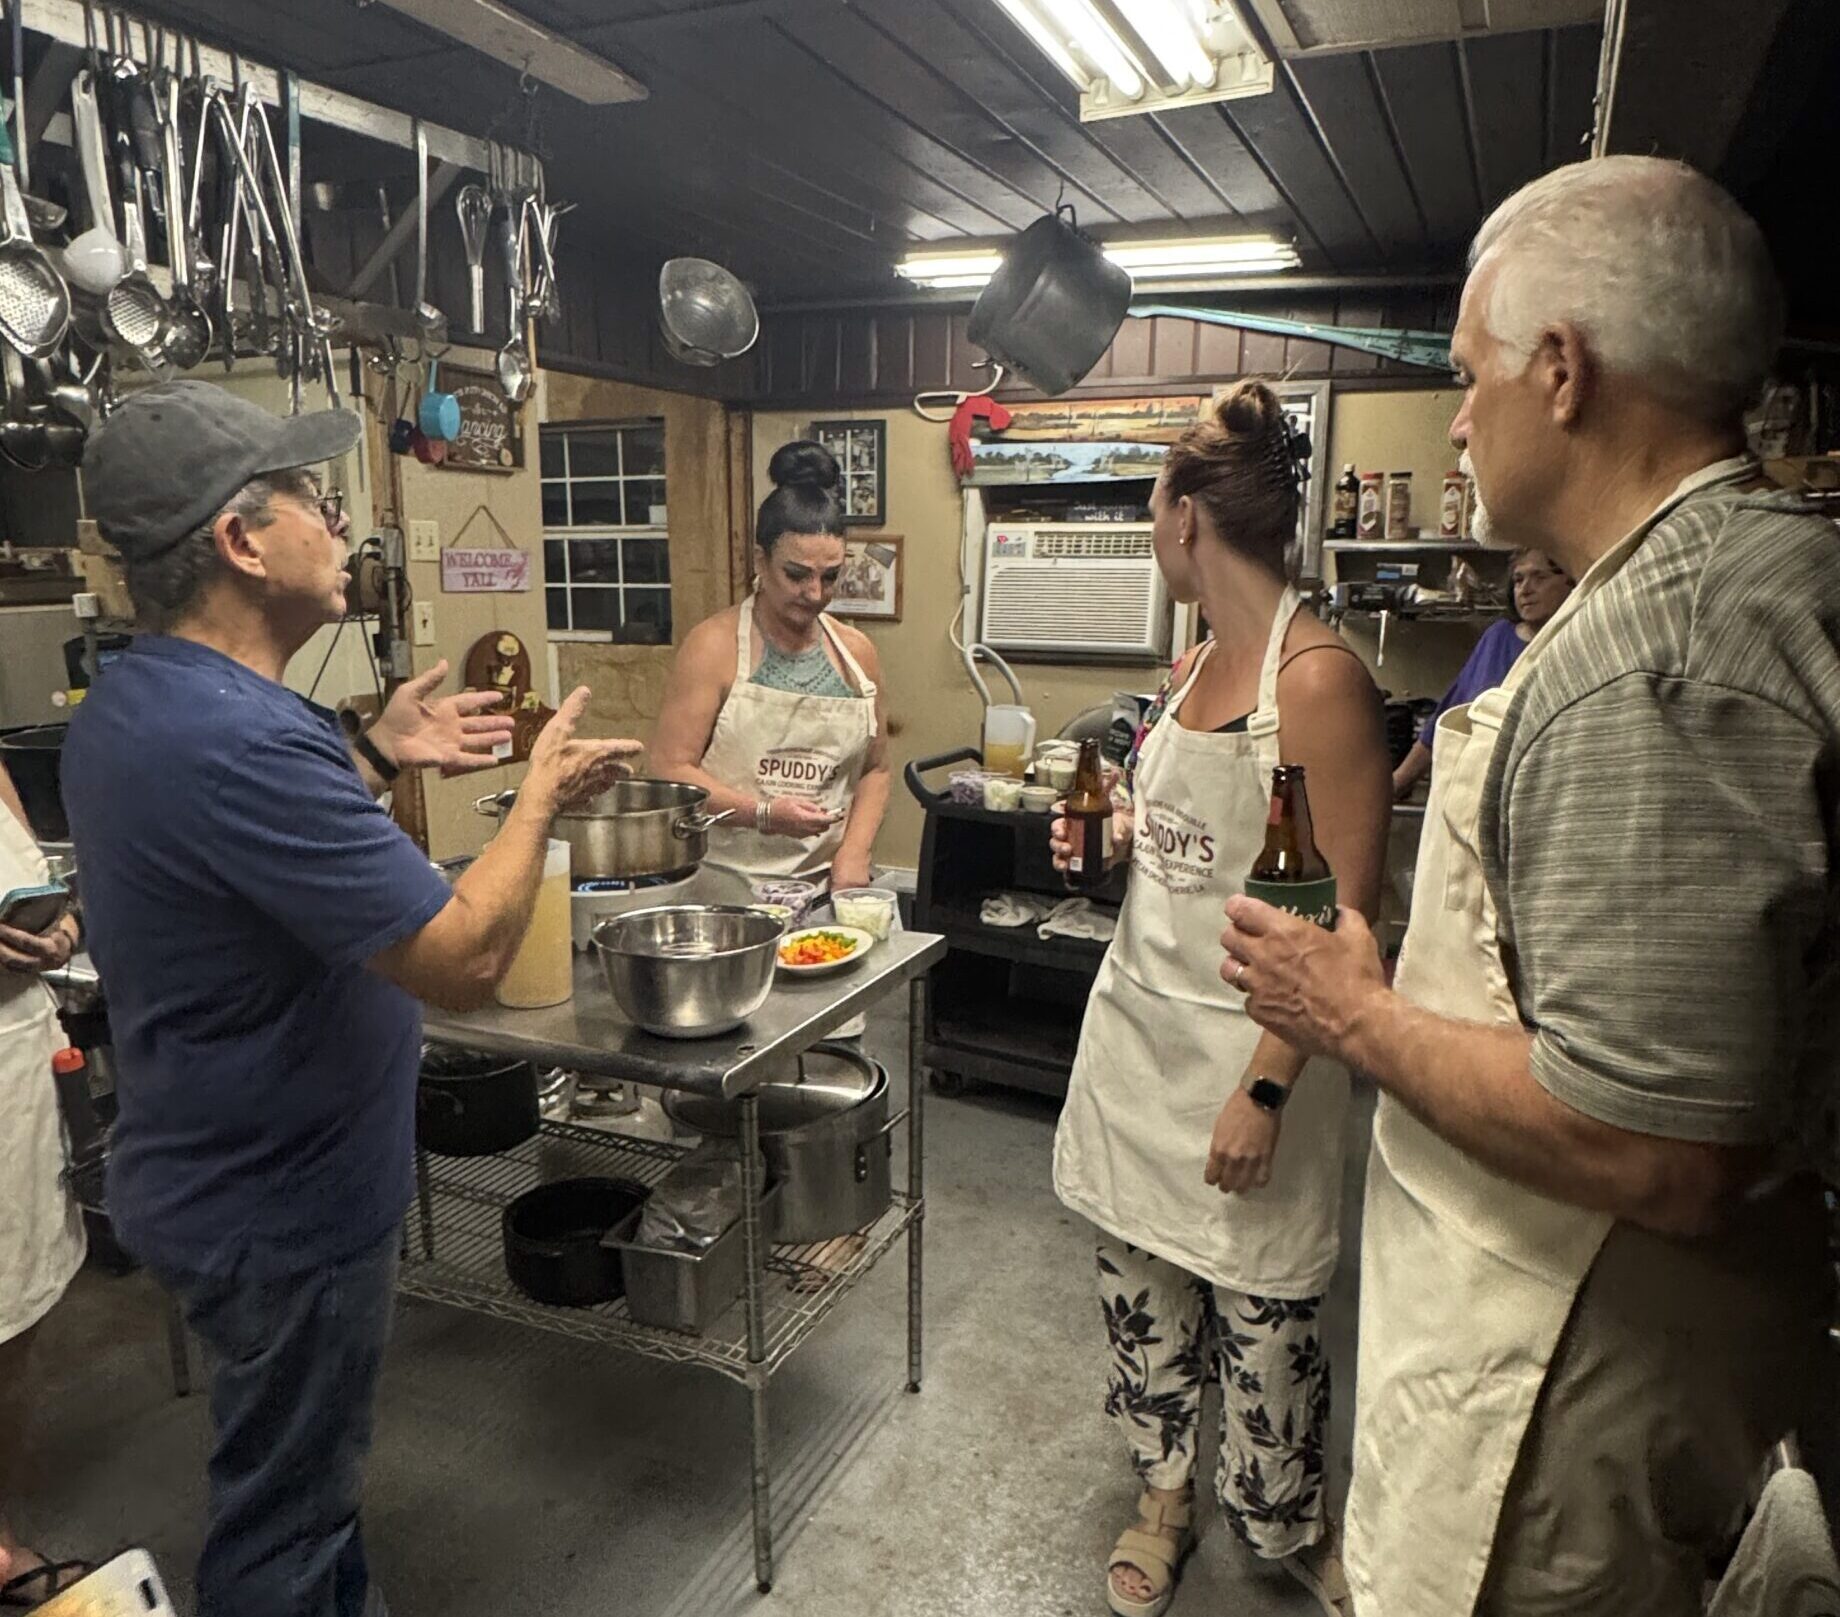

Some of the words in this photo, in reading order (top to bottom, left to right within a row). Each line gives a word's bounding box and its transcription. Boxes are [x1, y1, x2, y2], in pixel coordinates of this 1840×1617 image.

[1085, 511, 1110, 521] with
[1114, 511, 1124, 521] it
[445, 552, 512, 568] WELCOME
[758, 759, 840, 781] SPUDDY'S
[1165, 859, 1214, 878] EXPERIENCE
